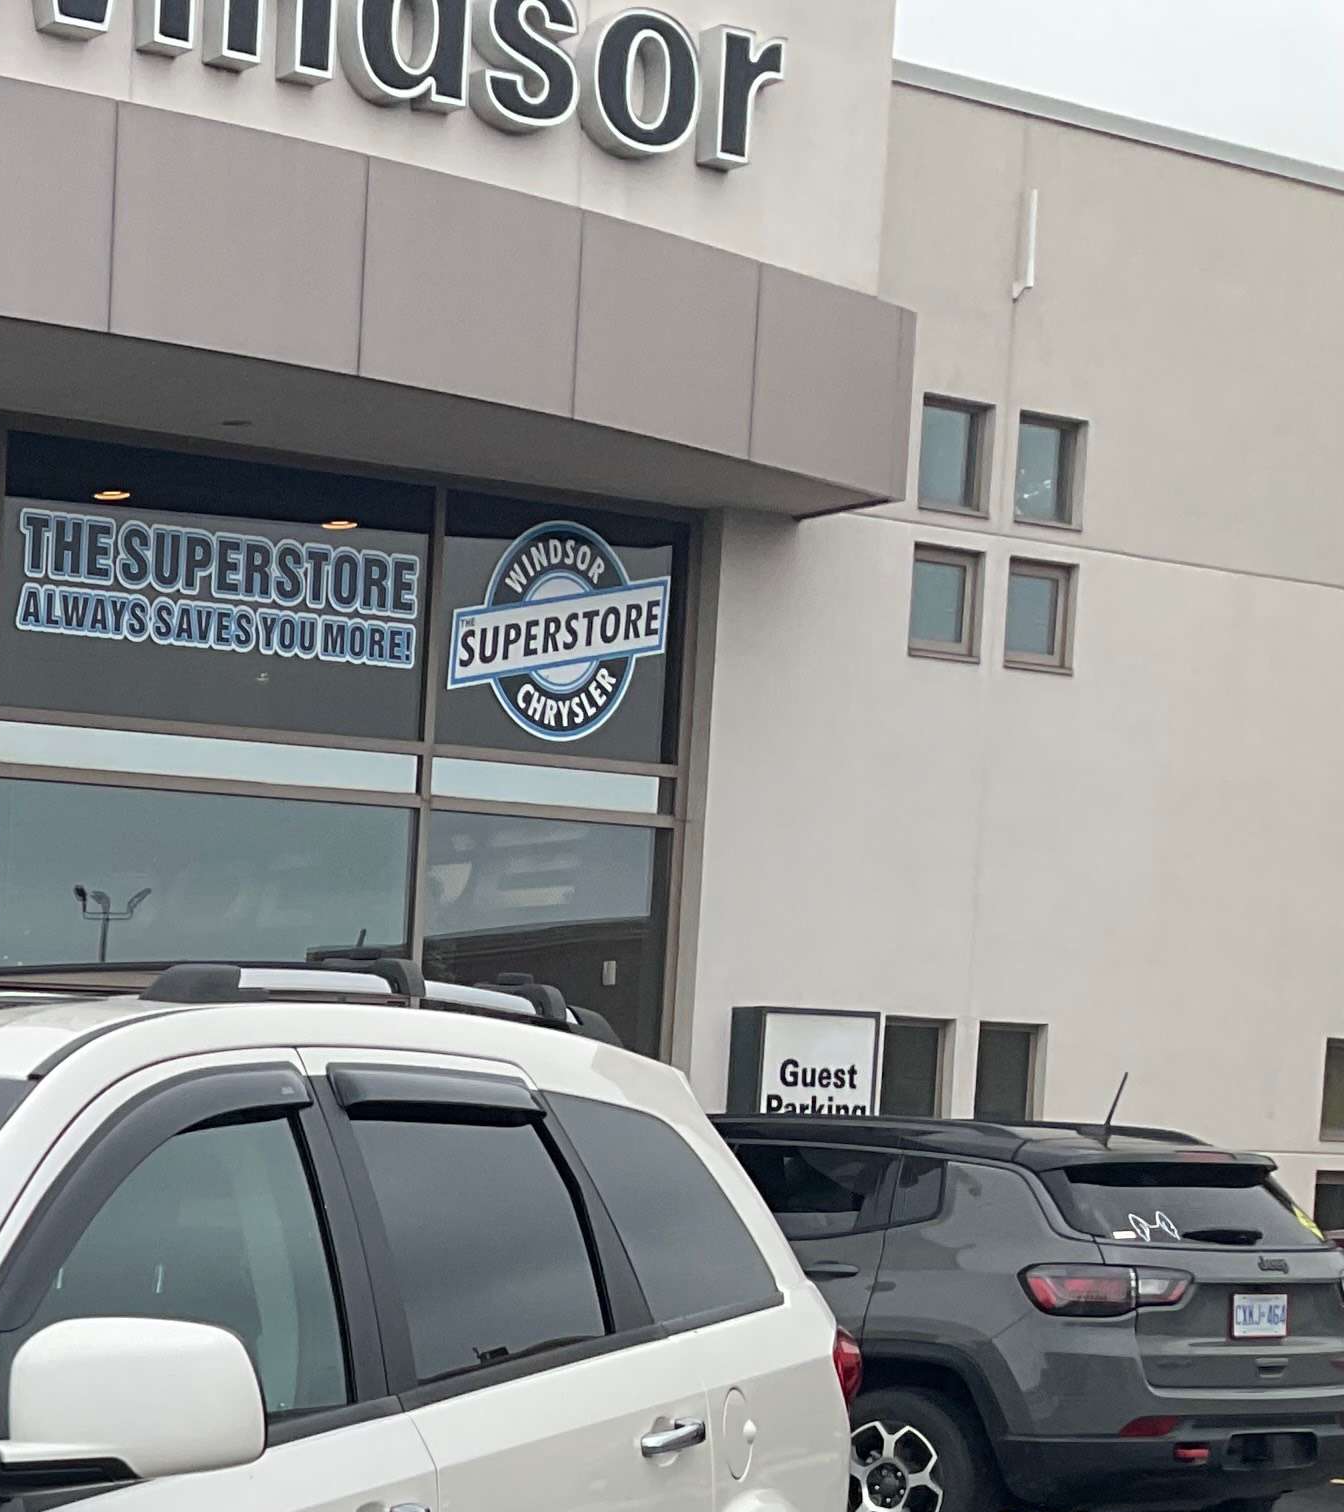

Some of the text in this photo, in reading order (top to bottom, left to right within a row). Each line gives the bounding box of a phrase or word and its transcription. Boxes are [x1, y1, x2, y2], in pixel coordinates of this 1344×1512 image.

[24, 515, 418, 613] THE SUPERSTORE
[505, 538, 605, 595] WINDSOR
[20, 590, 414, 663] ALWAYS SAVES YOU MORE!
[458, 600, 661, 668] SUPERSTORE
[516, 667, 617, 728] CHRYSLER
[779, 1058, 858, 1090] Guest
